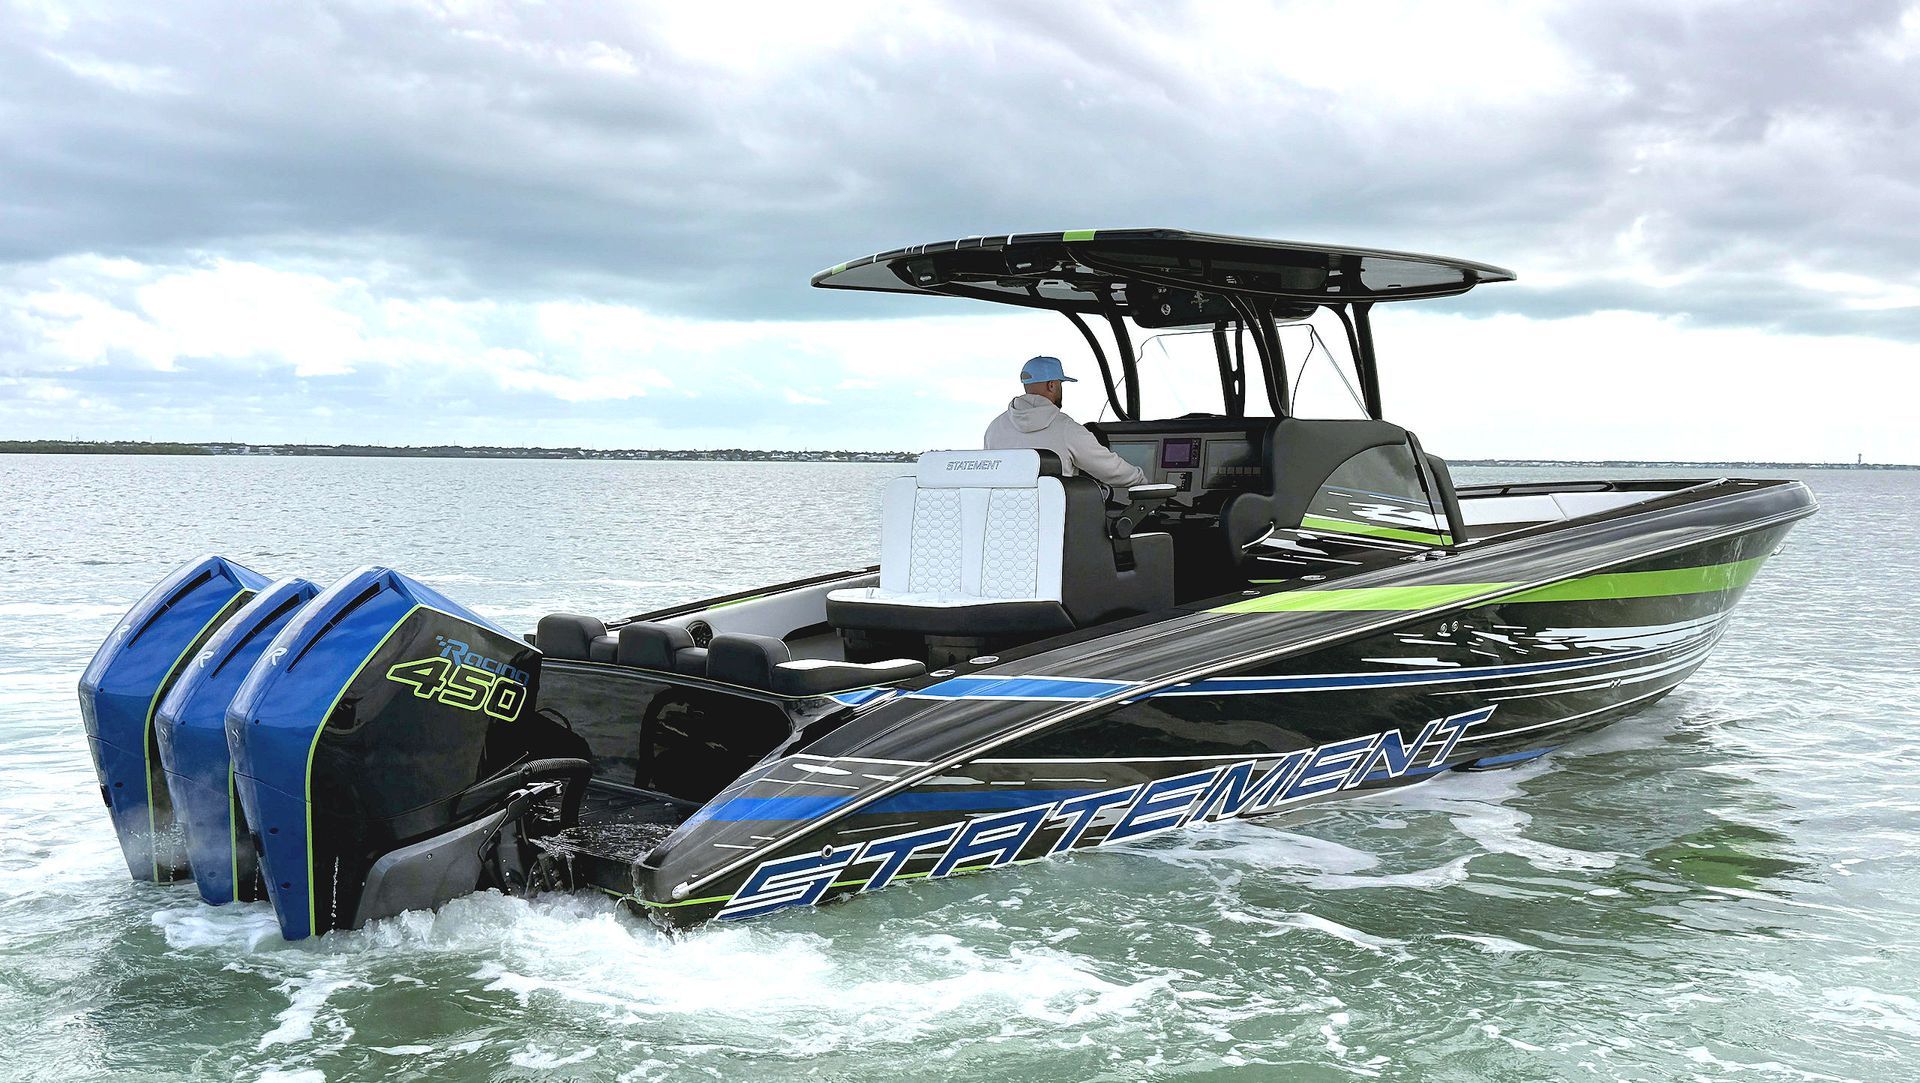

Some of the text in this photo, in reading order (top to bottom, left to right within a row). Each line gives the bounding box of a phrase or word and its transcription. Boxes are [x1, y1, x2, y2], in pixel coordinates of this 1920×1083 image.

[946, 460, 1002, 471] STATEMENT
[386, 656, 527, 722] 450
[713, 703, 1499, 921] STATEMENT
